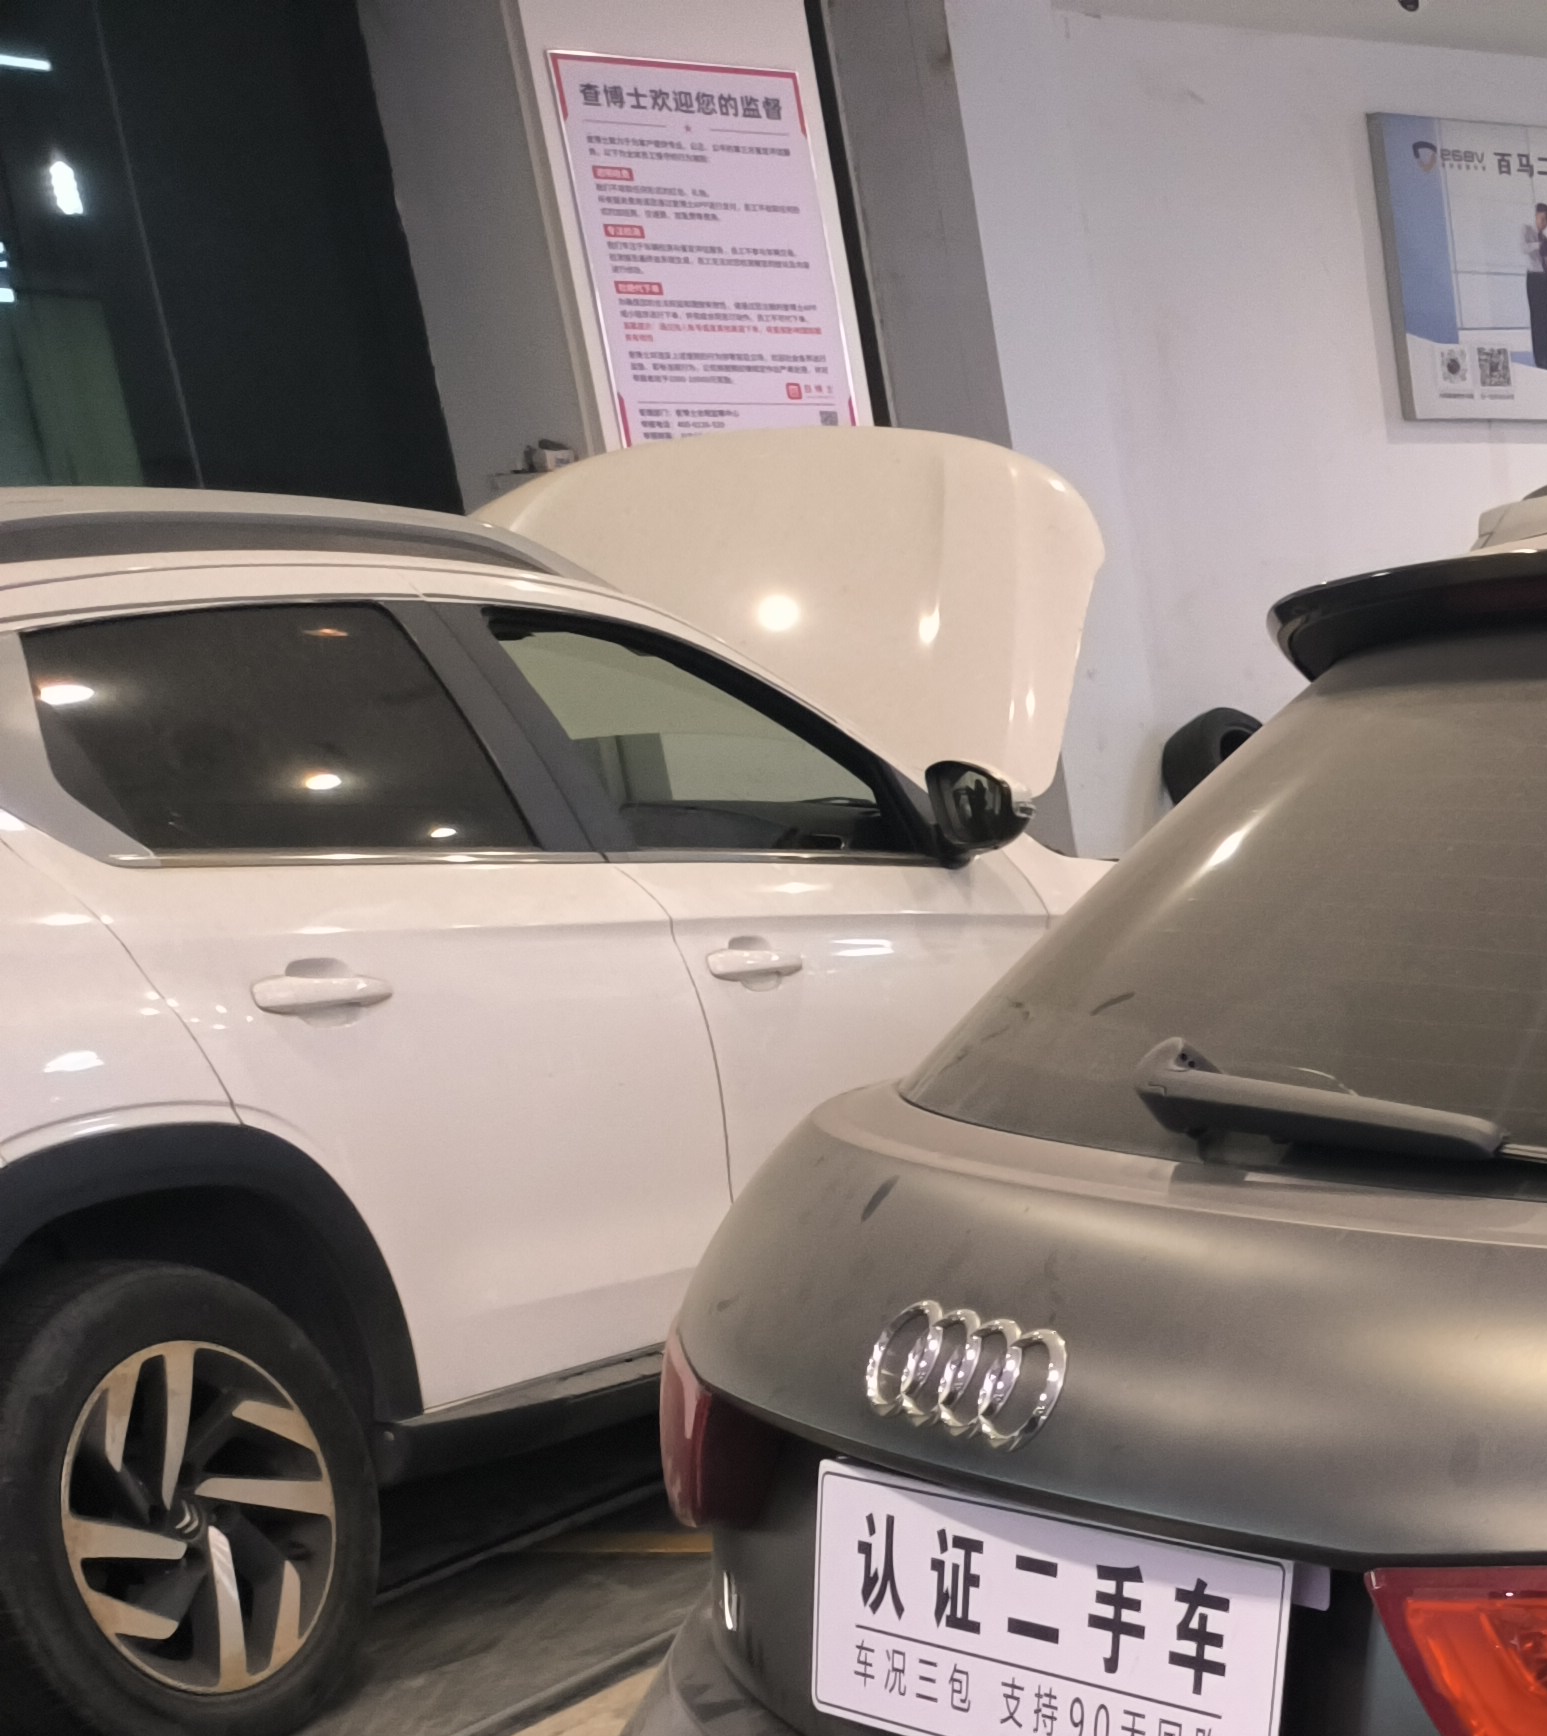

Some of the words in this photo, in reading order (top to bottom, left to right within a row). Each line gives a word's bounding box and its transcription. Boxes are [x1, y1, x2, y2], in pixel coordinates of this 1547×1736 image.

[579, 82, 783, 121] 查博士欢迎您的监督
[856, 1513, 1231, 1695] 认证二手车
[853, 1640, 971, 1714] 车况三包
